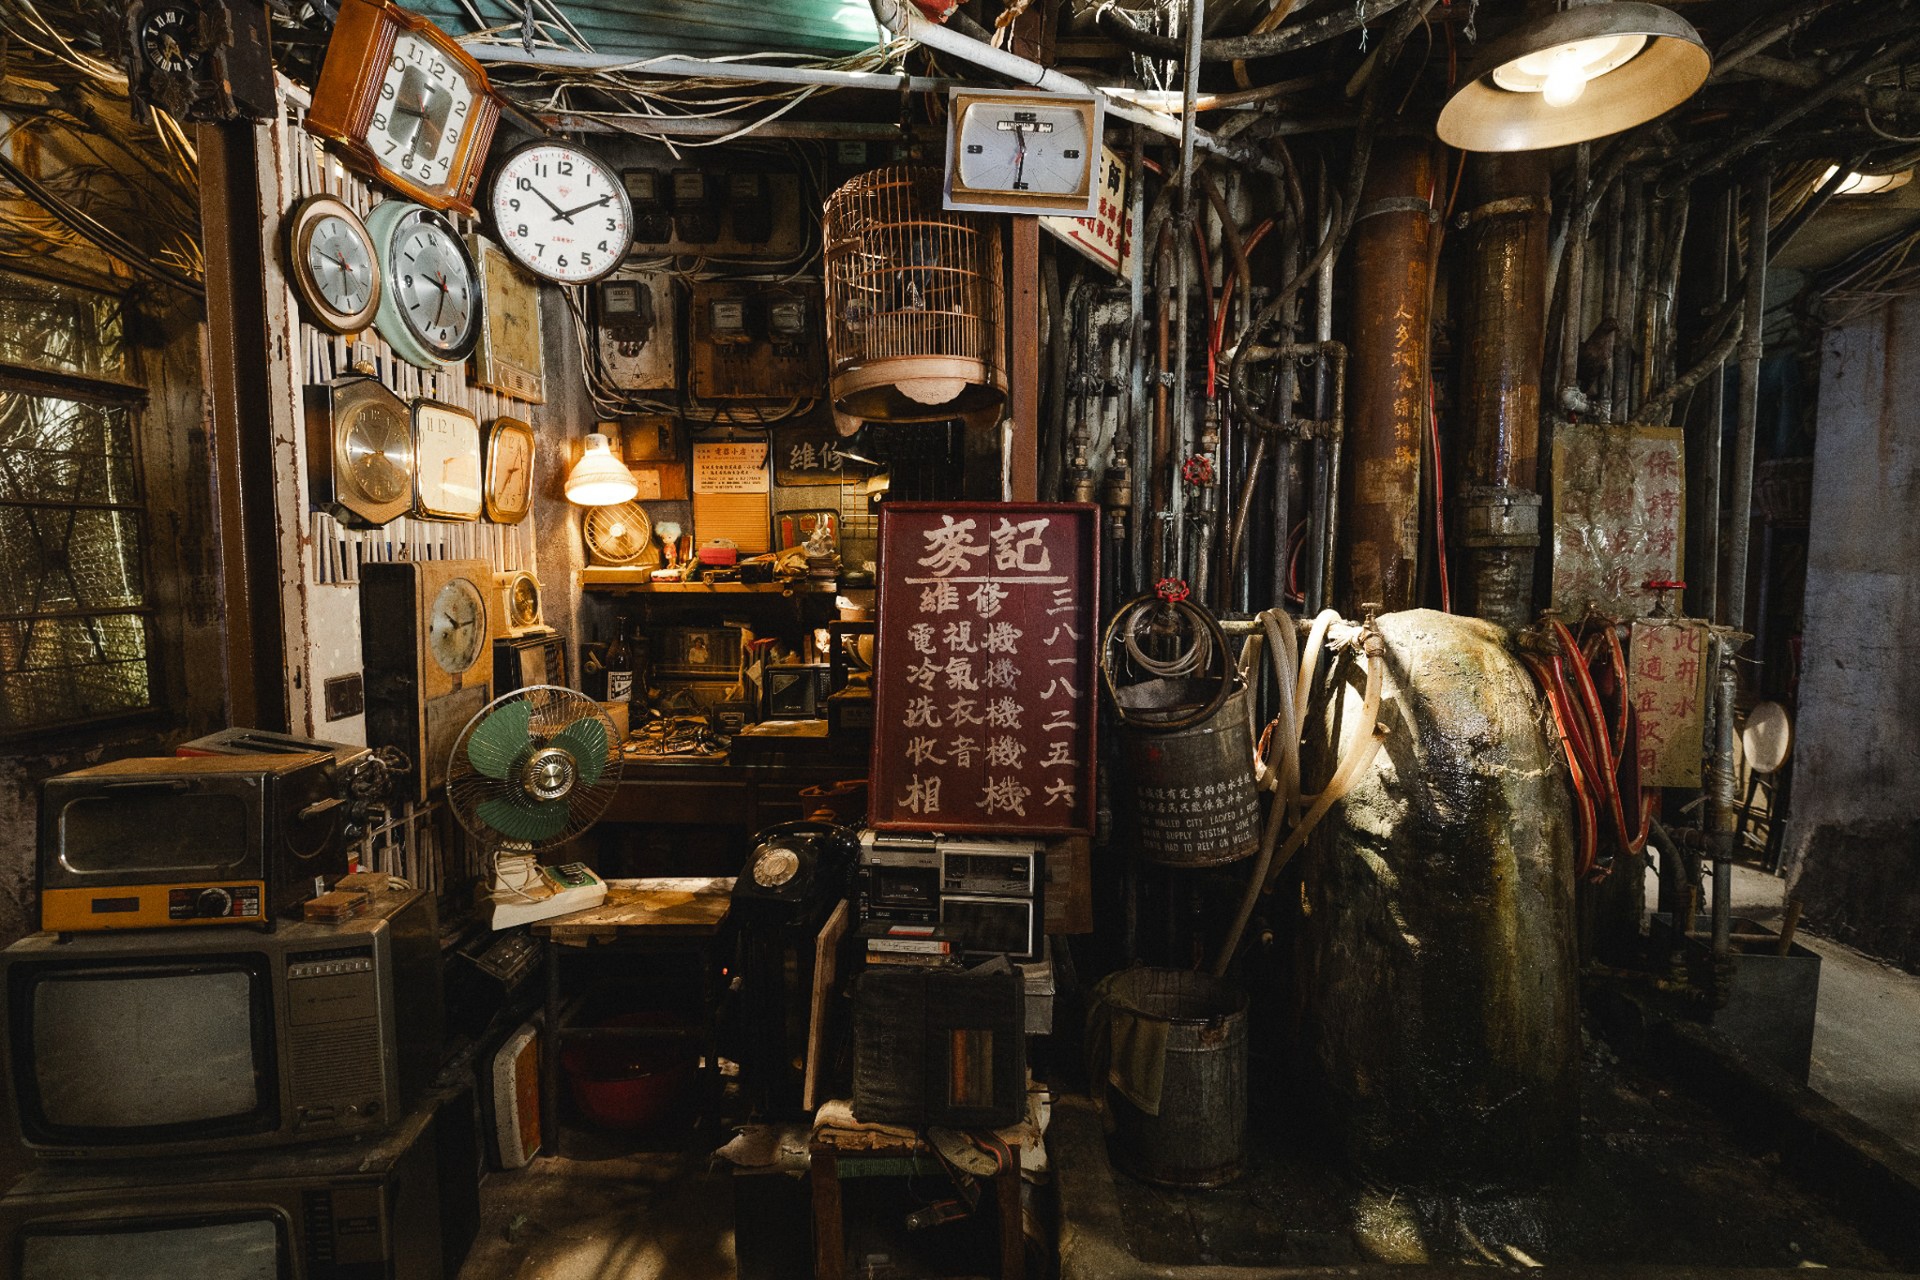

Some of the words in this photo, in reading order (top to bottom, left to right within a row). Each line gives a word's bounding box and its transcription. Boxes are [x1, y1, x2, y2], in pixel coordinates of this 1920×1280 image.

[155, 16, 165, 28] XI
[148, 26, 158, 36] X
[408, 43, 424, 65] 11
[391, 56, 405, 72] 0
[428, 58, 445, 80] 12
[381, 83, 394, 100] 9
[450, 76, 456, 91] 1
[455, 101, 466, 118] 2
[373, 113, 386, 131] 8
[447, 128, 458, 144] 3
[385, 140, 397, 155] 7
[401, 154, 413, 170] 6
[438, 157, 449, 170] 4
[535, 162, 547, 177] 11
[557, 161, 573, 177] 12
[420, 164, 431, 179] 5
[516, 176, 531, 192] 10
[586, 174, 591, 187] 1
[509, 198, 521, 212] 9
[600, 194, 611, 207] 2
[517, 224, 528, 237] 8
[605, 218, 617, 232] 3
[535, 243, 546, 257] 7
[597, 240, 608, 253] 4
[557, 254, 568, 268] 6
[581, 252, 591, 266] 5
[440, 329, 447, 342] 6
[426, 417, 433, 432] 11
[438, 419, 447, 434] 12
[789, 441, 845, 472] 維修
[919, 515, 1052, 576] 麥記
[919, 583, 1009, 618] 維修
[907, 621, 1024, 655] 電視機
[906, 657, 1021, 693] 冷氣機
[1670, 628, 1700, 718] 此井水
[1637, 626, 1666, 774] 不適宜飲用
[903, 694, 1024, 730] 洗衣機
[904, 735, 1027, 770] 收音機
[1155, 817, 1181, 828] WALLED
[1186, 817, 1203, 828] CITY
[1209, 810, 1236, 825] LACKED
[1166, 830, 1192, 840] SUPPLY
[1199, 826, 1230, 840] SYSTEM.
[1235, 817, 1249, 831] SOME
[1165, 842, 1179, 852] HAD
[1183, 843, 1193, 852] TO
[1197, 841, 1214, 852] RELY
[1219, 838, 1229, 848] ON
[1233, 830, 1252, 845] WELLS.
